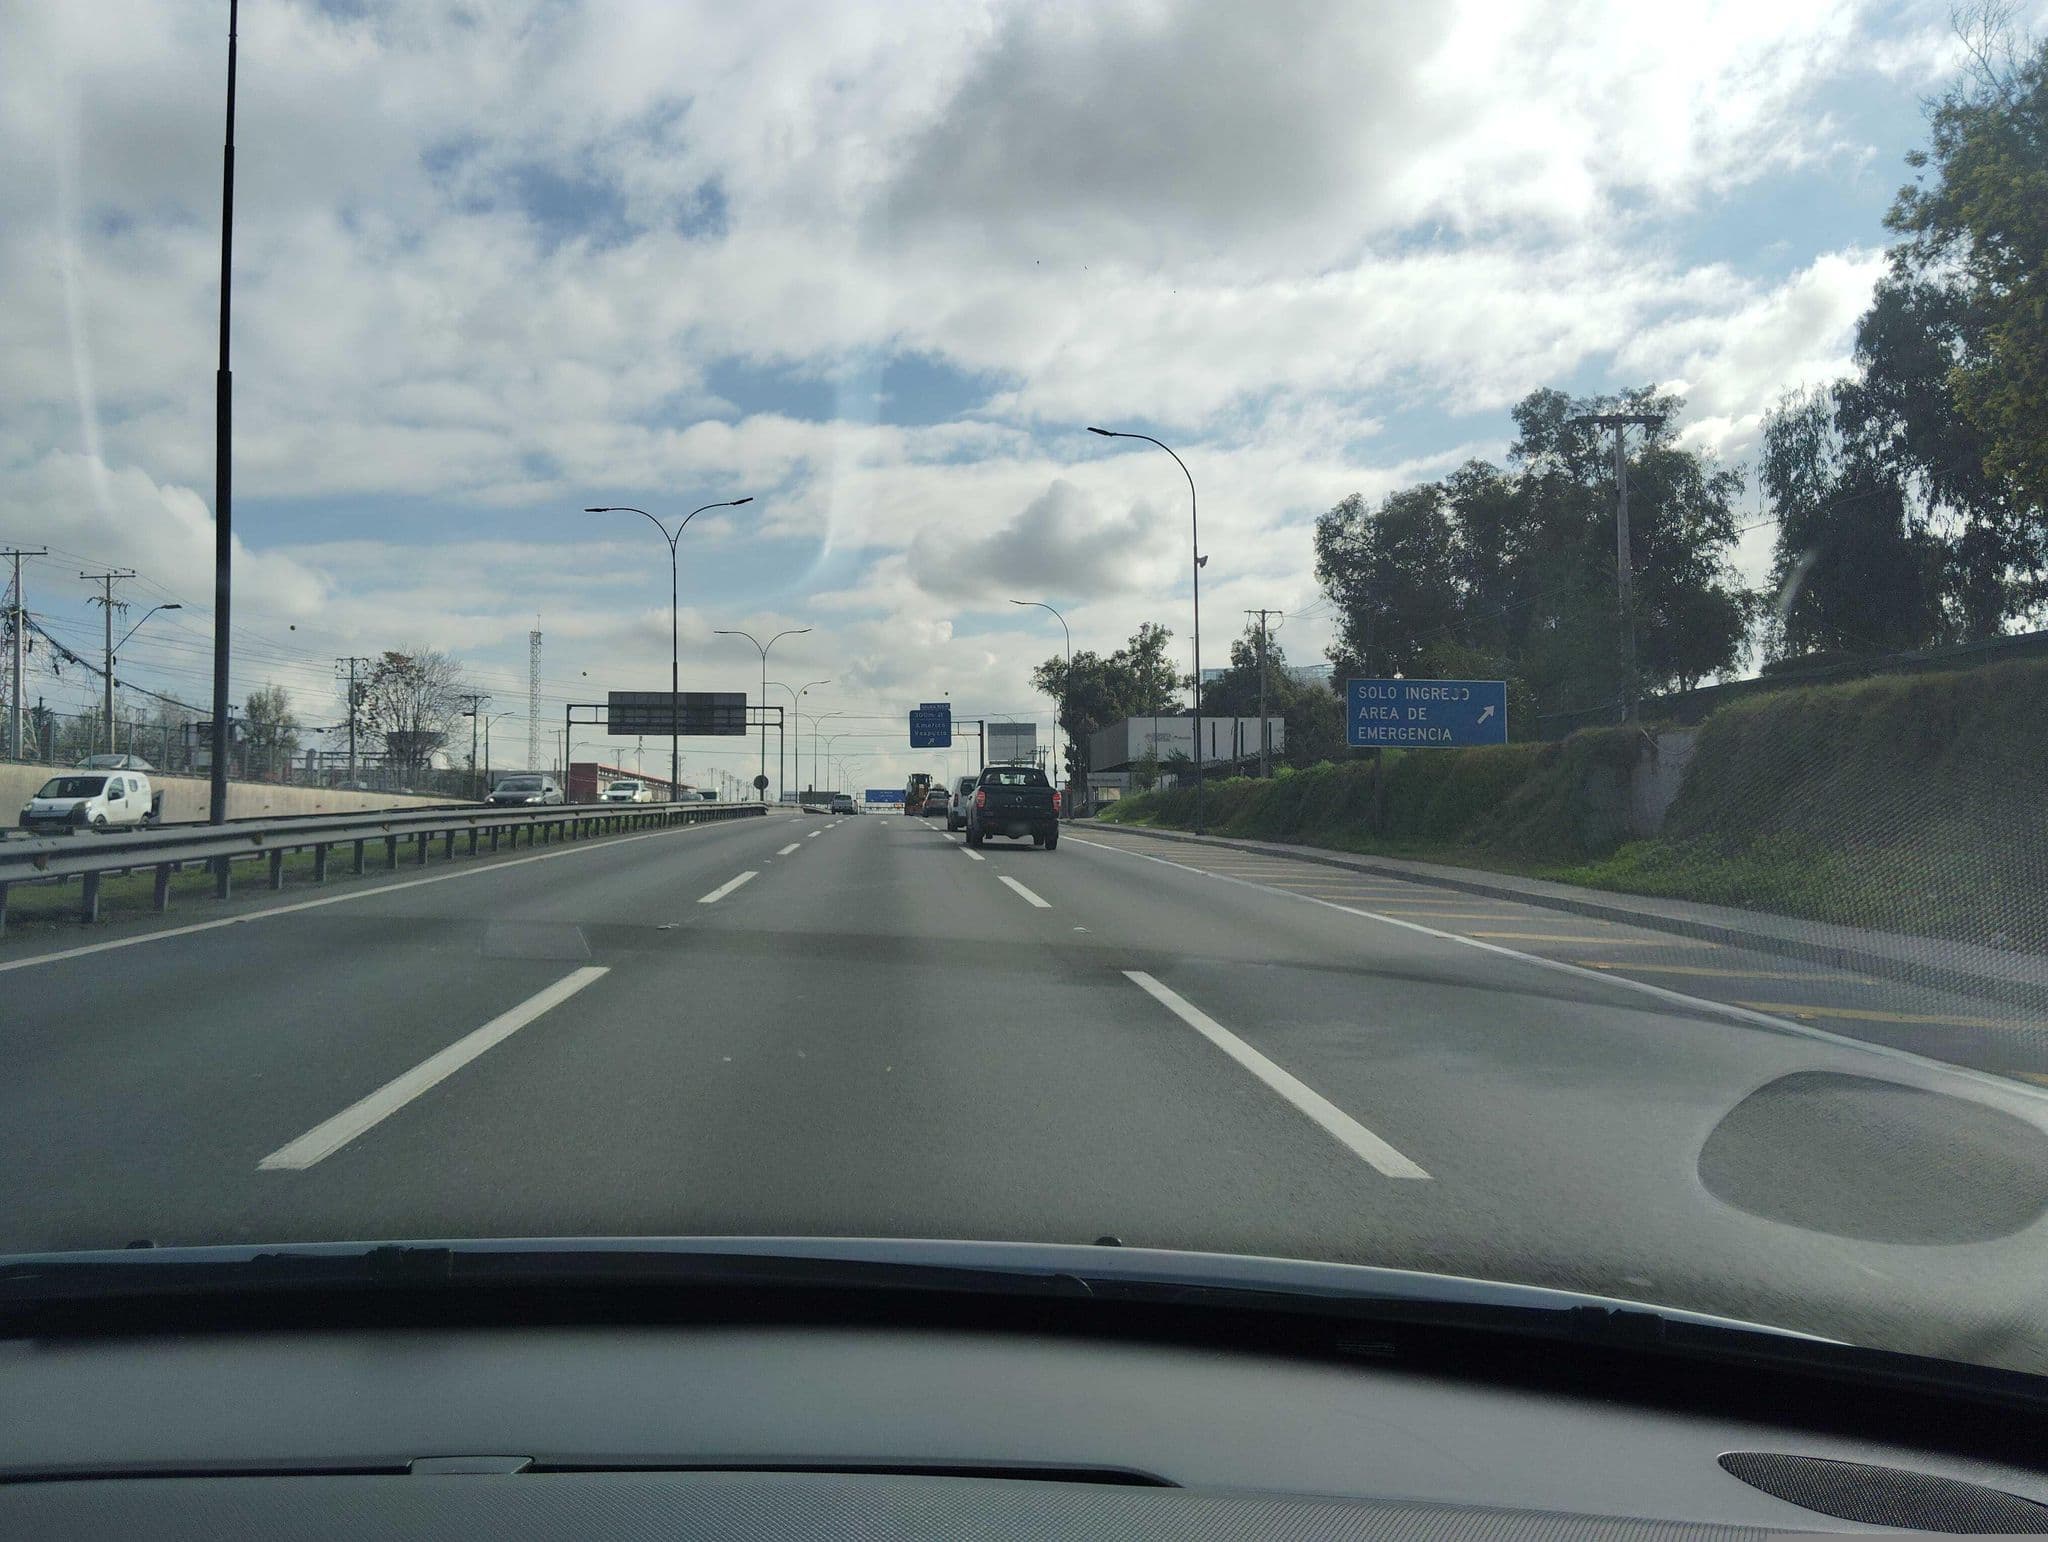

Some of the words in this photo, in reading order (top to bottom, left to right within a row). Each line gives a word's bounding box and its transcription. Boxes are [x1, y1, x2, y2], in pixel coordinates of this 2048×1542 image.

[1358, 686, 1397, 699] SOLO
[1358, 706, 1400, 720] AREA
[1408, 707, 1427, 720] DE
[1358, 726, 1453, 741] EMERGENCIA
